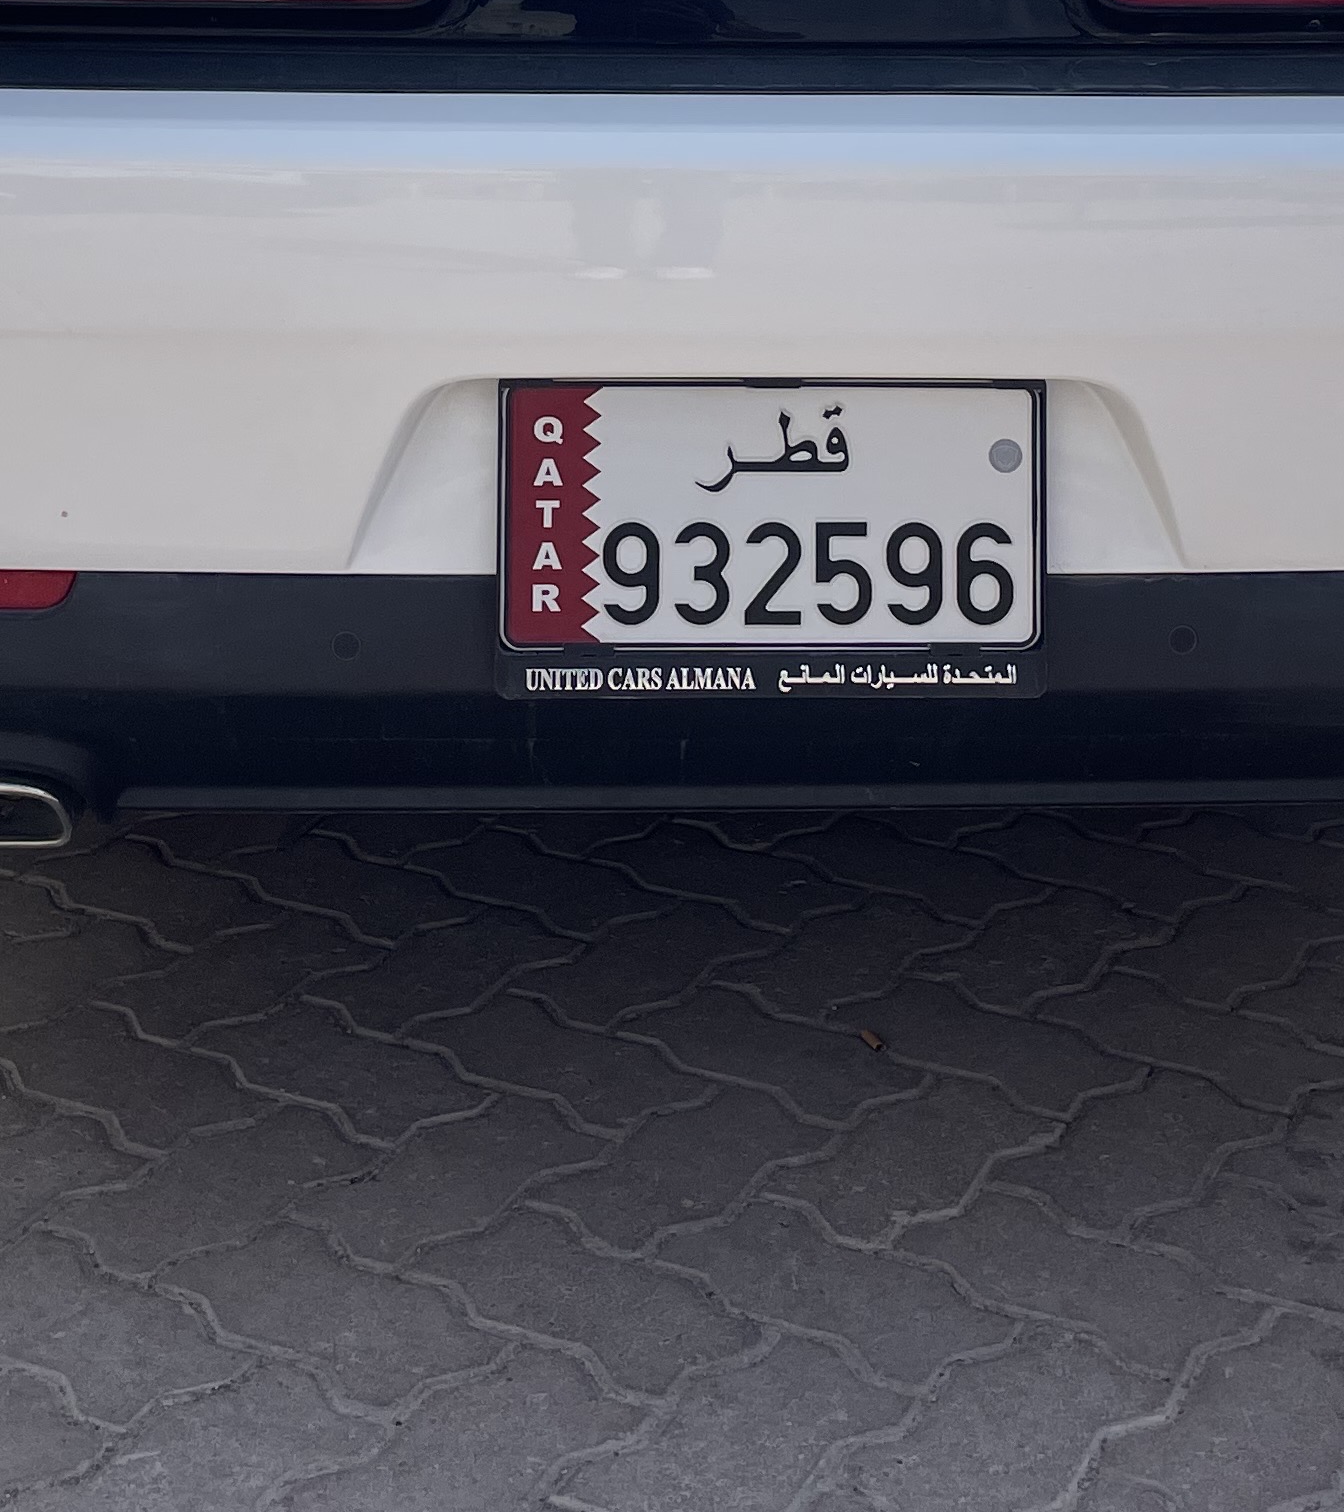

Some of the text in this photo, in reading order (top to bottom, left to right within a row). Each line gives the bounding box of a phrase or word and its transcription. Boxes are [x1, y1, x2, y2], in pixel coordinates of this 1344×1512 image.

[695, 405, 849, 492] قطر
[531, 415, 564, 613] QATAR
[602, 521, 1014, 626] 932596
[525, 668, 757, 691] UNITED CARS ALMANA
[778, 663, 1017, 693] المتحدة للسيارات المانع
